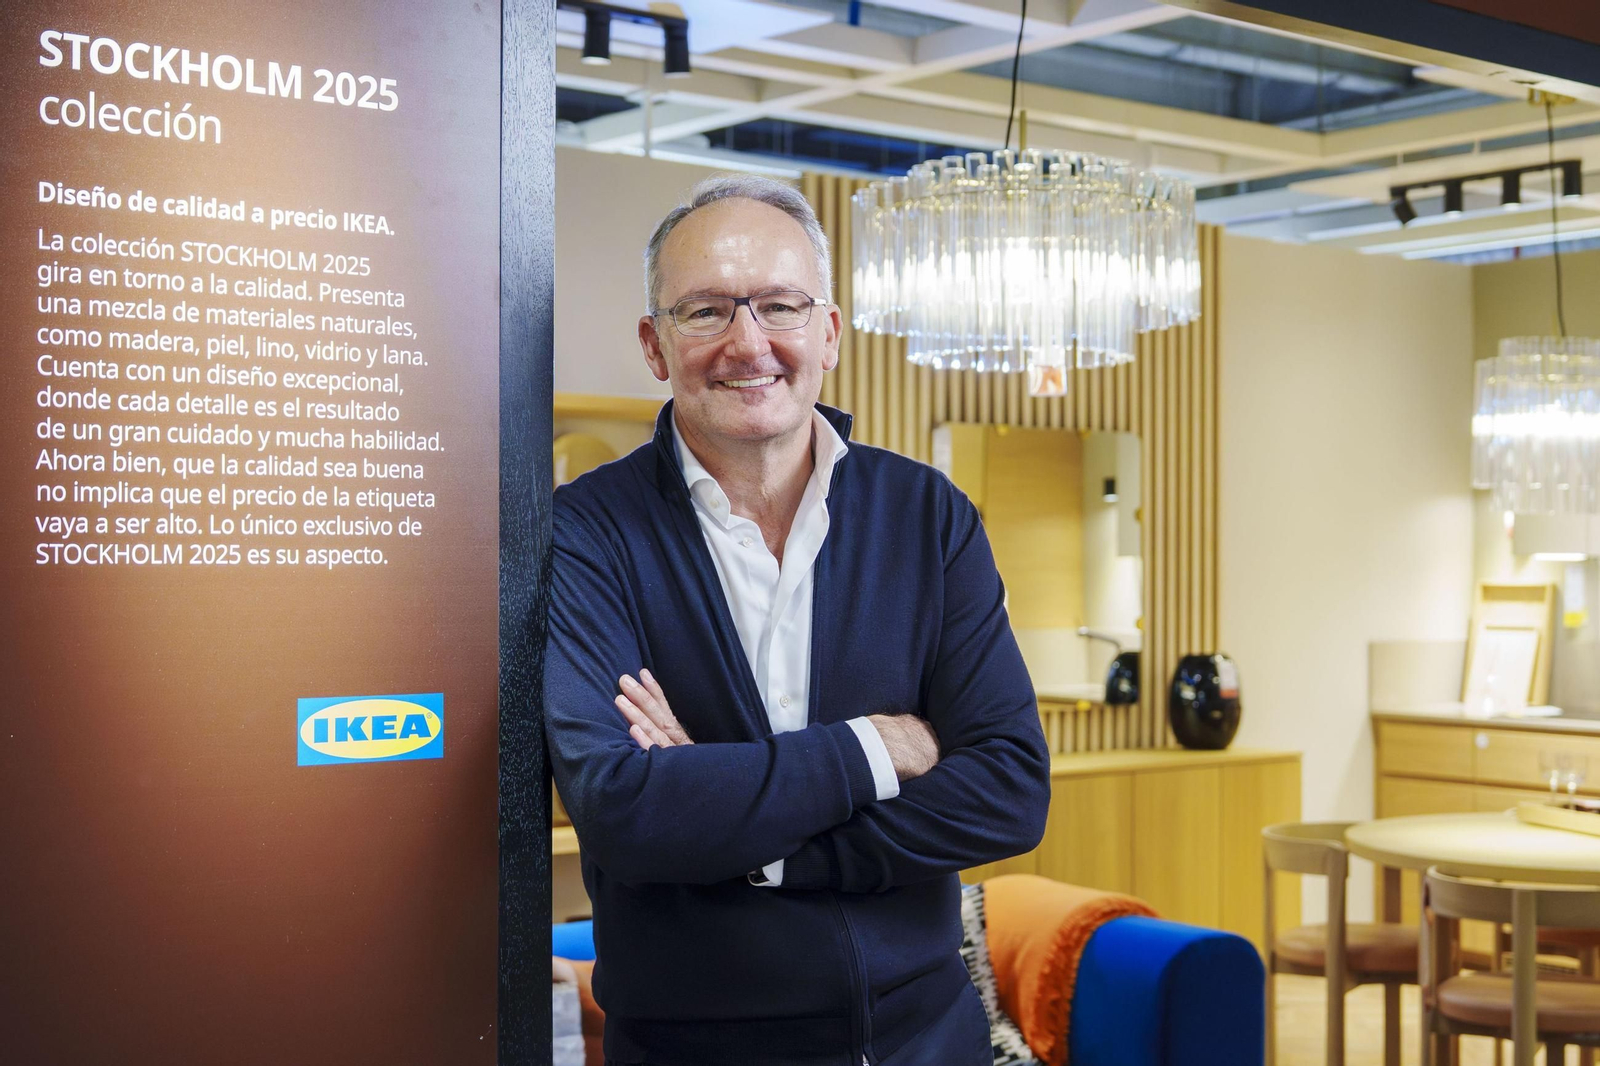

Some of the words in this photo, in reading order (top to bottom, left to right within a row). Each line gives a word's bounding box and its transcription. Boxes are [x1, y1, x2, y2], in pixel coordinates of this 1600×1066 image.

[39, 30, 302, 100] STOCKHOLM
[312, 68, 399, 112] 2025
[39, 90, 222, 145] colección
[38, 181, 122, 210] Diseño
[127, 189, 158, 214] de
[162, 195, 246, 222] calidad
[250, 206, 265, 224] a
[270, 208, 338, 231] precio
[343, 211, 395, 236] IKEA.
[38, 228, 64, 252] La
[70, 232, 175, 261] colección
[180, 240, 317, 272] STOCKHOLM
[322, 253, 371, 277] 2025
[37, 260, 82, 288] gira
[88, 268, 117, 287] en
[122, 268, 185, 292] torno
[190, 276, 204, 293] a
[210, 272, 228, 295] la
[233, 276, 313, 302] calidad.
[319, 282, 405, 308] Presenta
[37, 296, 82, 315] una
[88, 298, 166, 321] mezcla
[172, 300, 200, 323] de
[206, 307, 316, 331] materiales
[321, 315, 418, 340] naturales,
[37, 327, 102, 348] como
[109, 329, 200, 357] madera,
[206, 333, 250, 360] piel,
[256, 335, 299, 362] lino,
[304, 340, 362, 363] vidrio
[366, 348, 378, 369] y
[383, 343, 429, 366] lana.
[37, 354, 119, 380] Cuenta
[125, 363, 166, 382] con
[172, 366, 200, 384] un
[206, 363, 277, 388] diseño
[282, 371, 404, 396] excepcional,
[36, 384, 111, 410] donde
[117, 390, 170, 413] cada
[175, 391, 249, 416] detalle
[254, 400, 278, 417] es
[282, 397, 300, 418] el
[306, 399, 400, 422] resultado
[36, 416, 66, 440] de
[73, 423, 102, 441] un
[108, 424, 161, 448] gran
[166, 422, 253, 446] cuidado
[257, 430, 271, 452] y
[275, 427, 345, 449] mucha
[351, 428, 445, 452] habilidad.
[35, 448, 106, 472] Ahora
[112, 449, 167, 477] bien,
[173, 457, 215, 480] que
[221, 453, 239, 475] la
[244, 454, 318, 477] calidad
[323, 461, 357, 478] sea
[363, 457, 424, 480] buena
[37, 484, 67, 502] no
[73, 480, 154, 509] implica
[160, 487, 202, 510] que
[207, 483, 226, 505] el
[232, 485, 297, 511] precio
[302, 485, 328, 507] de
[333, 485, 350, 507] la
[355, 487, 435, 513] etiqueta
[35, 516, 89, 540] vaya
[95, 517, 108, 534] a
[115, 517, 151, 534] ser
[155, 512, 203, 535] alto.
[209, 514, 235, 535] Lo
[241, 513, 298, 536] único
[302, 514, 393, 536] exclusivo
[398, 515, 423, 536] de
[35, 542, 183, 565] STOCKHOLM
[189, 543, 242, 565] 2025
[246, 548, 271, 565] es
[275, 548, 300, 565] su
[305, 546, 389, 570] aspecto.
[313, 713, 432, 744] IKEA
